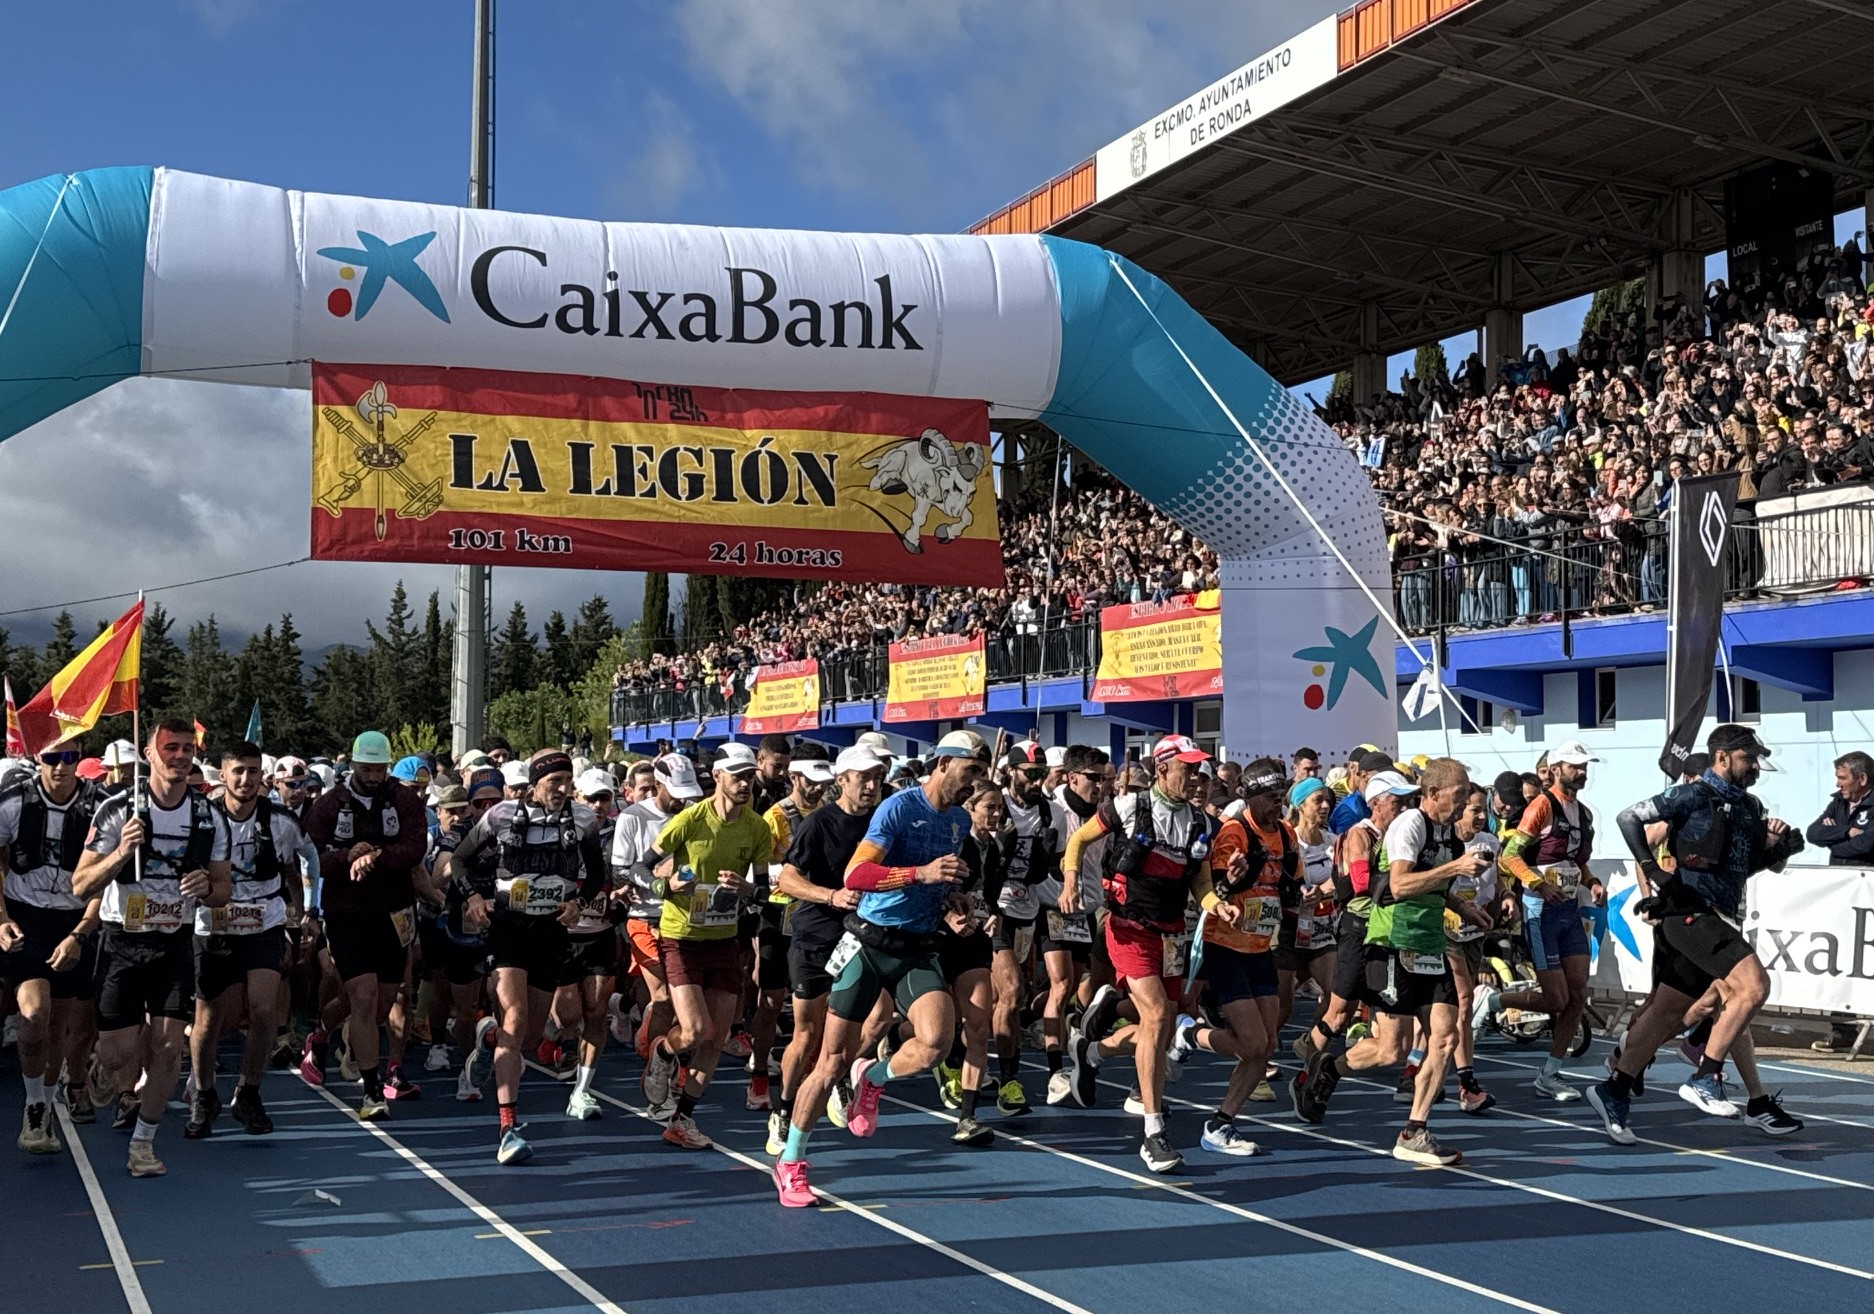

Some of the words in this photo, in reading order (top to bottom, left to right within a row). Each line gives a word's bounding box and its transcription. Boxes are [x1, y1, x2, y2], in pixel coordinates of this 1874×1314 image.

[1154, 109, 1196, 140] EXCMO.
[1199, 48, 1291, 115] AYUNTAMIENTO
[1190, 123, 1205, 146] DE
[1209, 98, 1252, 136] RONDA
[1795, 219, 1823, 237] VISITANTE
[1732, 241, 1758, 258] LOCAL
[469, 245, 925, 351] CaixaBank
[448, 433, 547, 494] LA
[565, 436, 840, 508] LEGIÓN
[448, 528, 505, 550] 101
[517, 528, 573, 554] km
[708, 542, 748, 567] 24
[754, 541, 842, 568] horas
[528, 887, 564, 900] 2392
[146, 903, 183, 916] 10212
